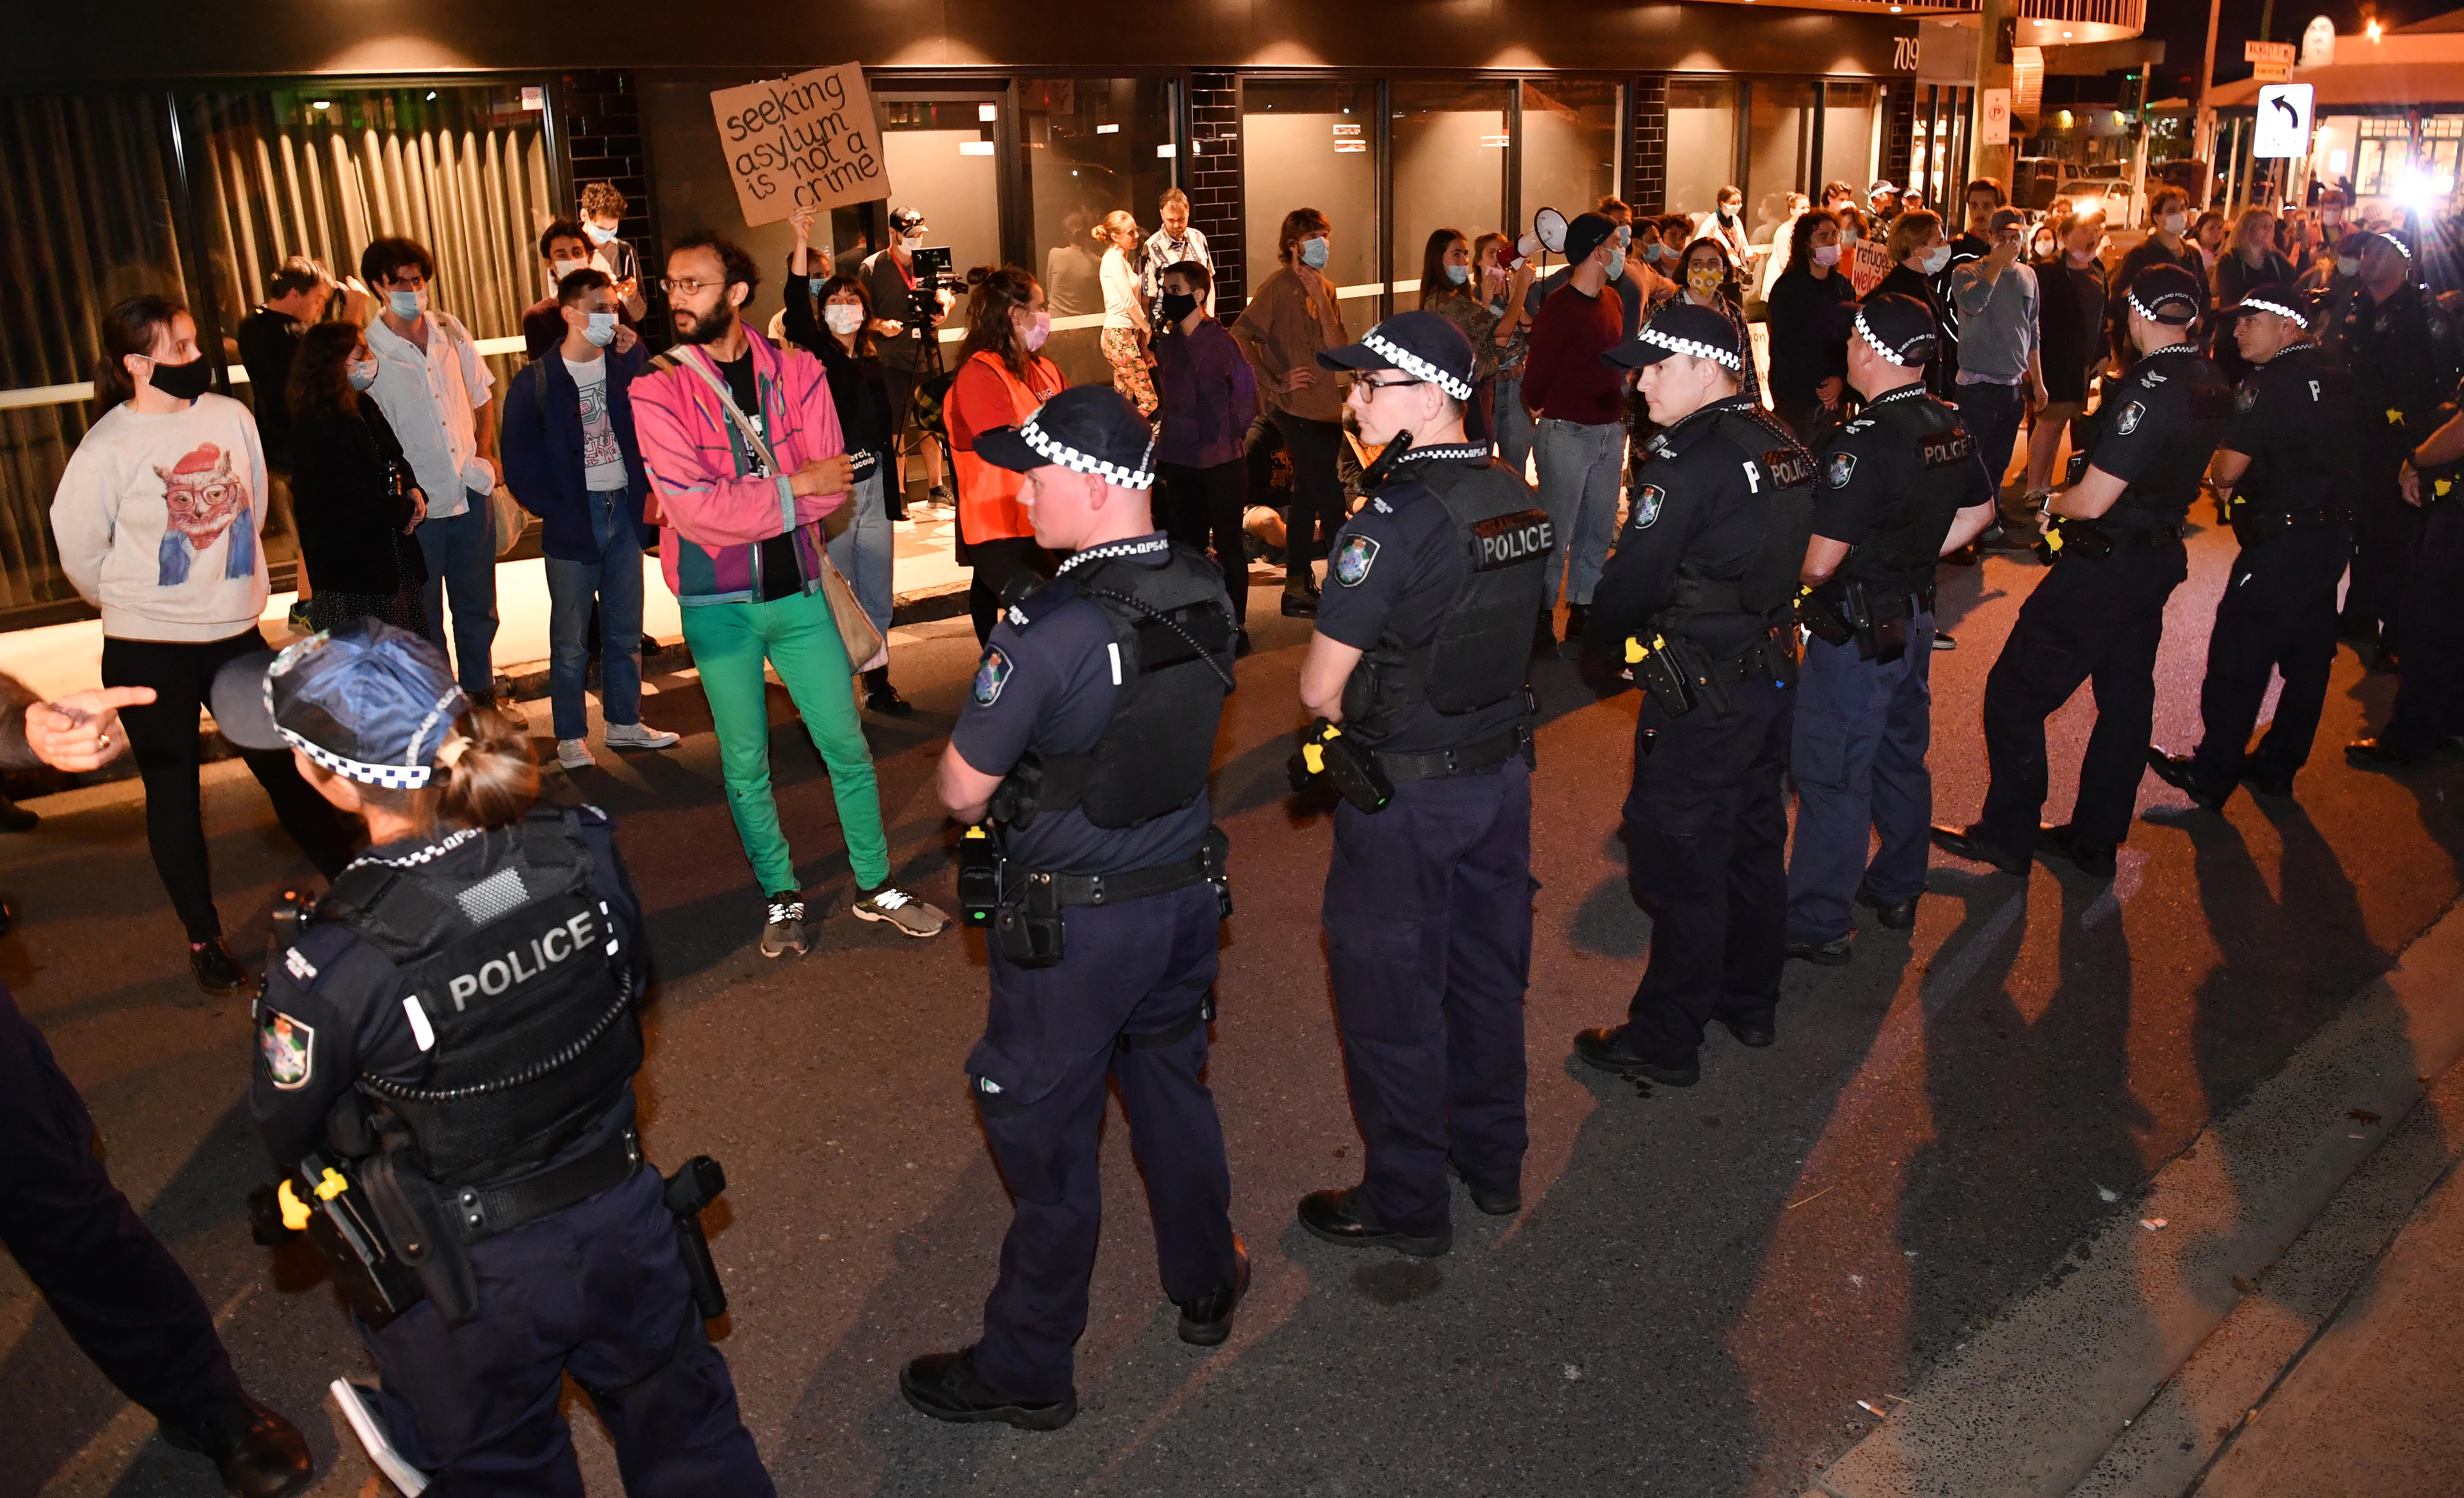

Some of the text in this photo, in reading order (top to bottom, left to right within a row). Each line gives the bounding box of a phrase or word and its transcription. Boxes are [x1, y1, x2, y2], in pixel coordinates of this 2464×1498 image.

[1894, 36, 1920, 70] 709
[727, 72, 846, 141] seeking
[736, 112, 849, 176] asylum
[746, 130, 868, 200] is not a
[794, 153, 878, 206] crime
[1750, 329, 1766, 342] ion
[850, 448, 871, 462] erci,
[853, 457, 875, 470] ucoup
[1924, 438, 1968, 465] POLICE
[1770, 459, 1807, 485] POLIC
[1483, 522, 1552, 563] POLICE
[448, 911, 595, 1012] POLICE
